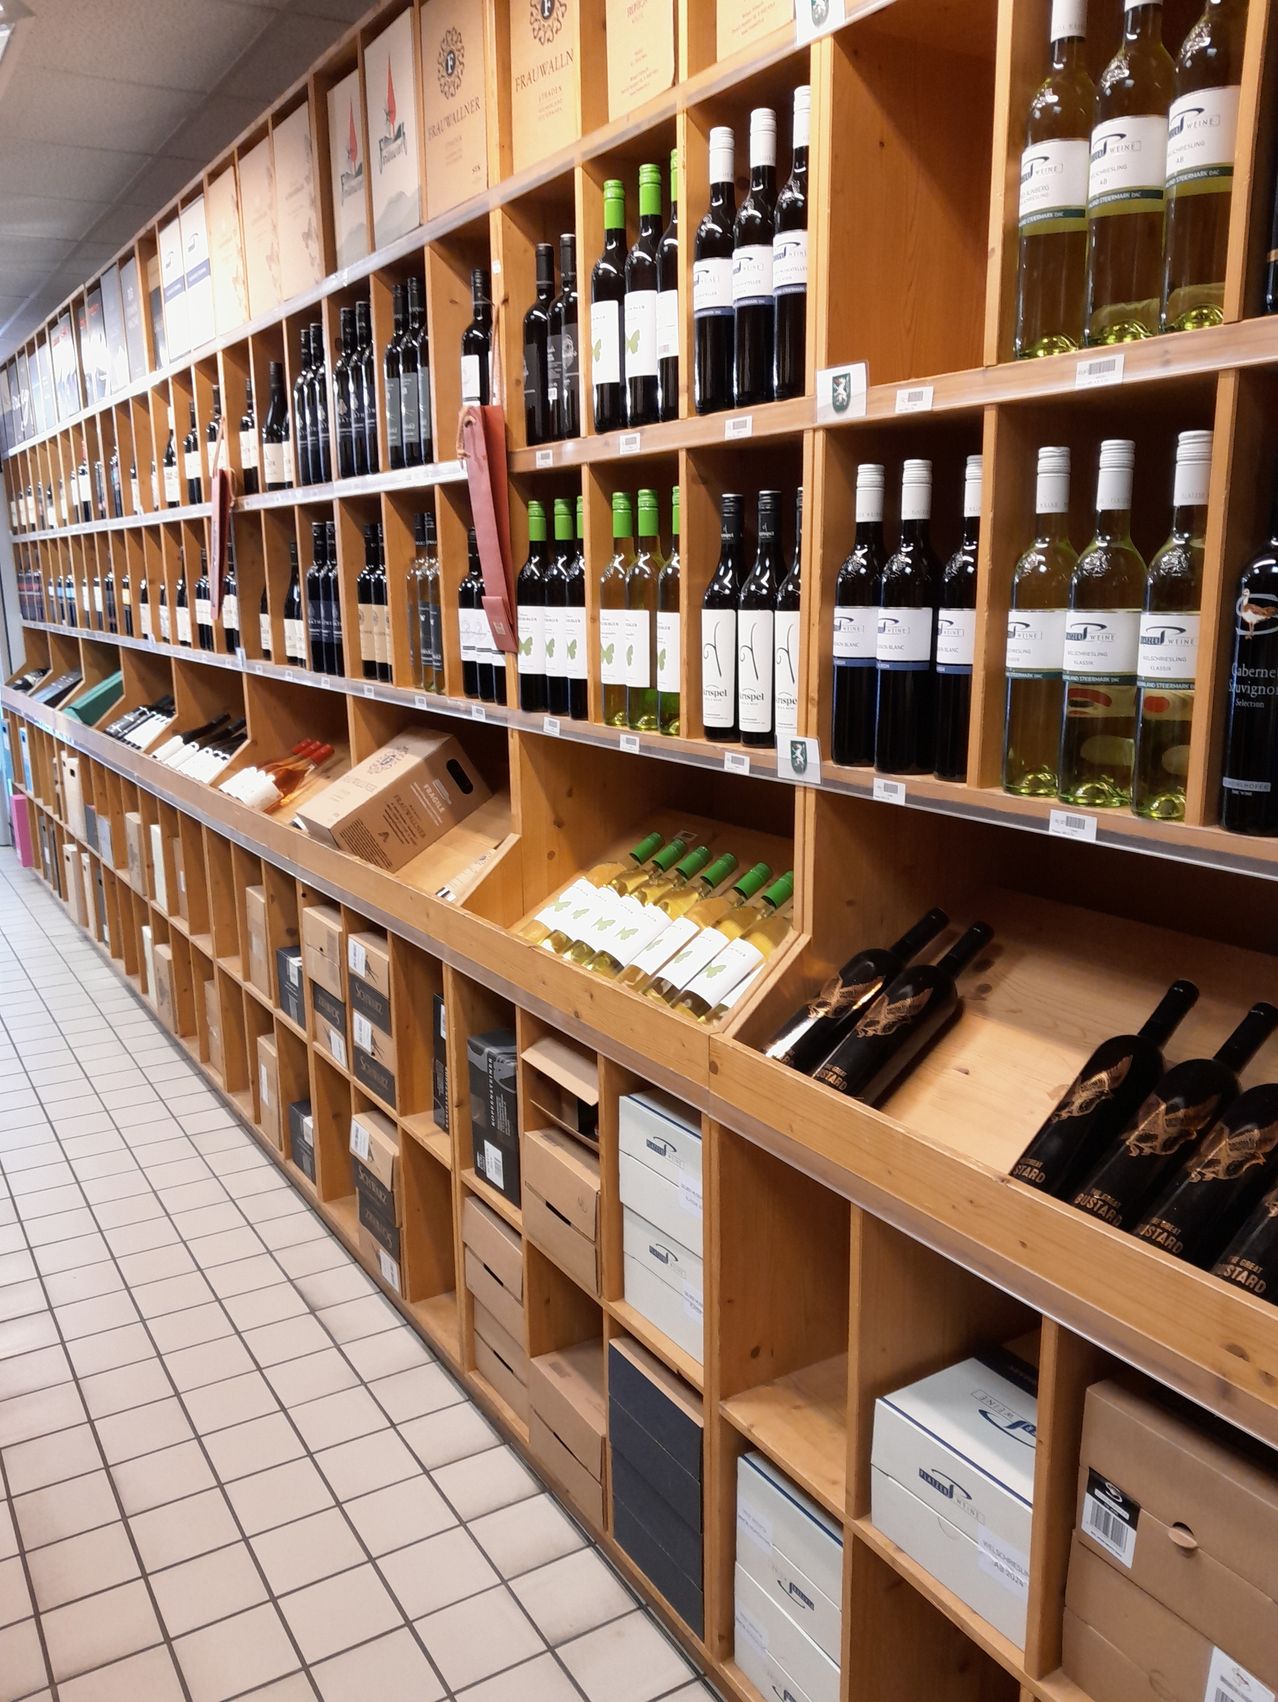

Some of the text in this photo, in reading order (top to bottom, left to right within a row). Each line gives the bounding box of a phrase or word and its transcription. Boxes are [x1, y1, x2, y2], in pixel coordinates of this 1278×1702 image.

[427, 96, 481, 141] FRAUWALLNER
[1090, 633, 1115, 642] WEINE
[1167, 637, 1195, 646] WEINE
[1231, 663, 1278, 679] Caberne
[703, 688, 728, 698] rispel
[1235, 698, 1265, 709] Selection
[423, 783, 446, 814] FRAGILE
[355, 979, 384, 1016] SCHWARZ
[360, 1054, 390, 1090] SCHWARZ
[488, 1056, 497, 1129] KOPPENSTEINER
[1073, 1192, 1124, 1227] BUSTARD
[1160, 1219, 1182, 1237] GREAT
[1239, 1258, 1265, 1275] GREAT
[979, 1394, 1015, 1420] WEINE
